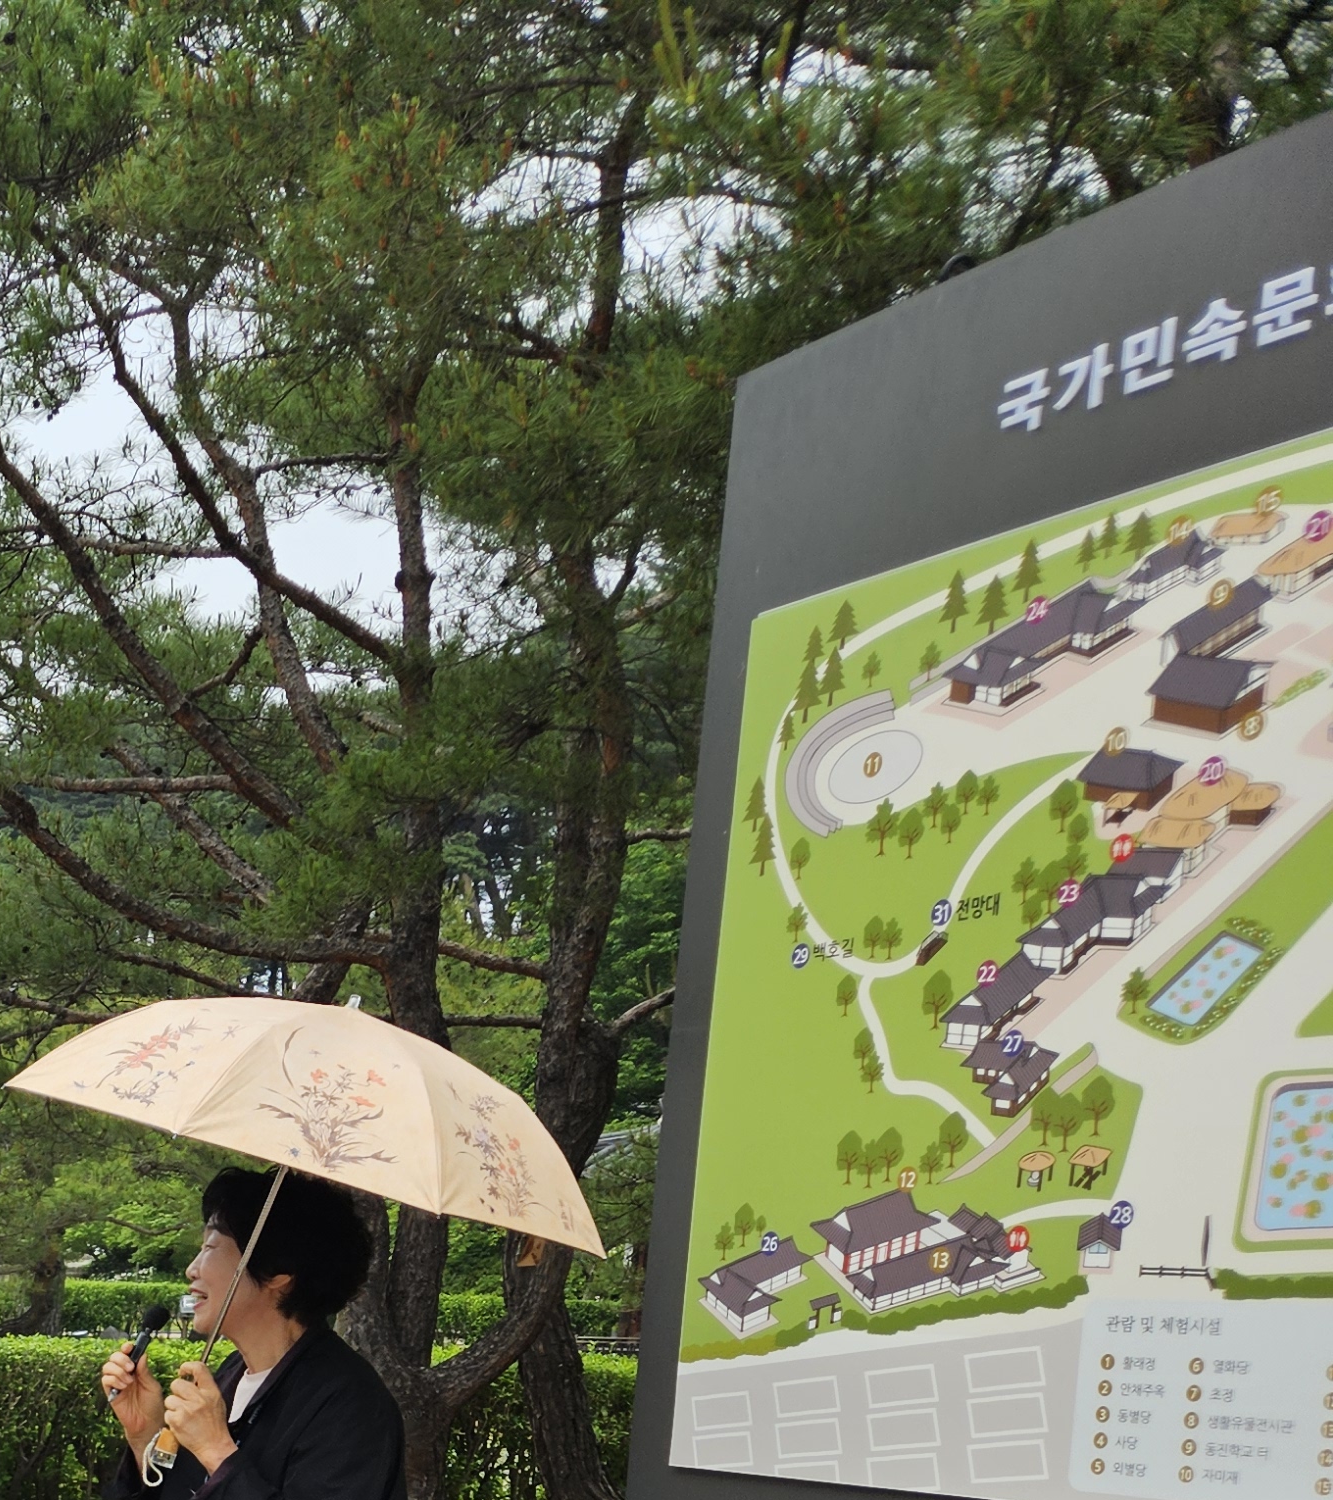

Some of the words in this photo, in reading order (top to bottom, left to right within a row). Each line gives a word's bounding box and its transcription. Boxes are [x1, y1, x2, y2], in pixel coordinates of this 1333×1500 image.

[997, 266, 1333, 432] 국가민속문
[1256, 489, 1282, 514] 15
[1169, 519, 1192, 540] 14
[1306, 516, 1331, 539] 21
[1027, 601, 1048, 622] 24
[1107, 731, 1127, 751] 10
[864, 756, 881, 774] 11
[1199, 760, 1224, 782] 20
[1059, 885, 1078, 902] 23
[933, 903, 950, 924] 31
[956, 893, 1001, 922] 전망대
[793, 948, 809, 965] 29
[813, 937, 855, 960] 백호길
[977, 966, 997, 982] 22
[1003, 1035, 1022, 1053] 27
[899, 1172, 915, 1188] 12
[1111, 1206, 1131, 1223] 28
[762, 1236, 778, 1252] 26
[932, 1252, 949, 1269] 13
[1106, 1315, 1135, 1333] 관람
[1141, 1316, 1154, 1333] 및
[1160, 1317, 1222, 1335] 체험시설
[1117, 1409, 1151, 1425] 동별당
[1115, 1436, 1138, 1451] 사당
[1112, 1462, 1147, 1478] 외별당
